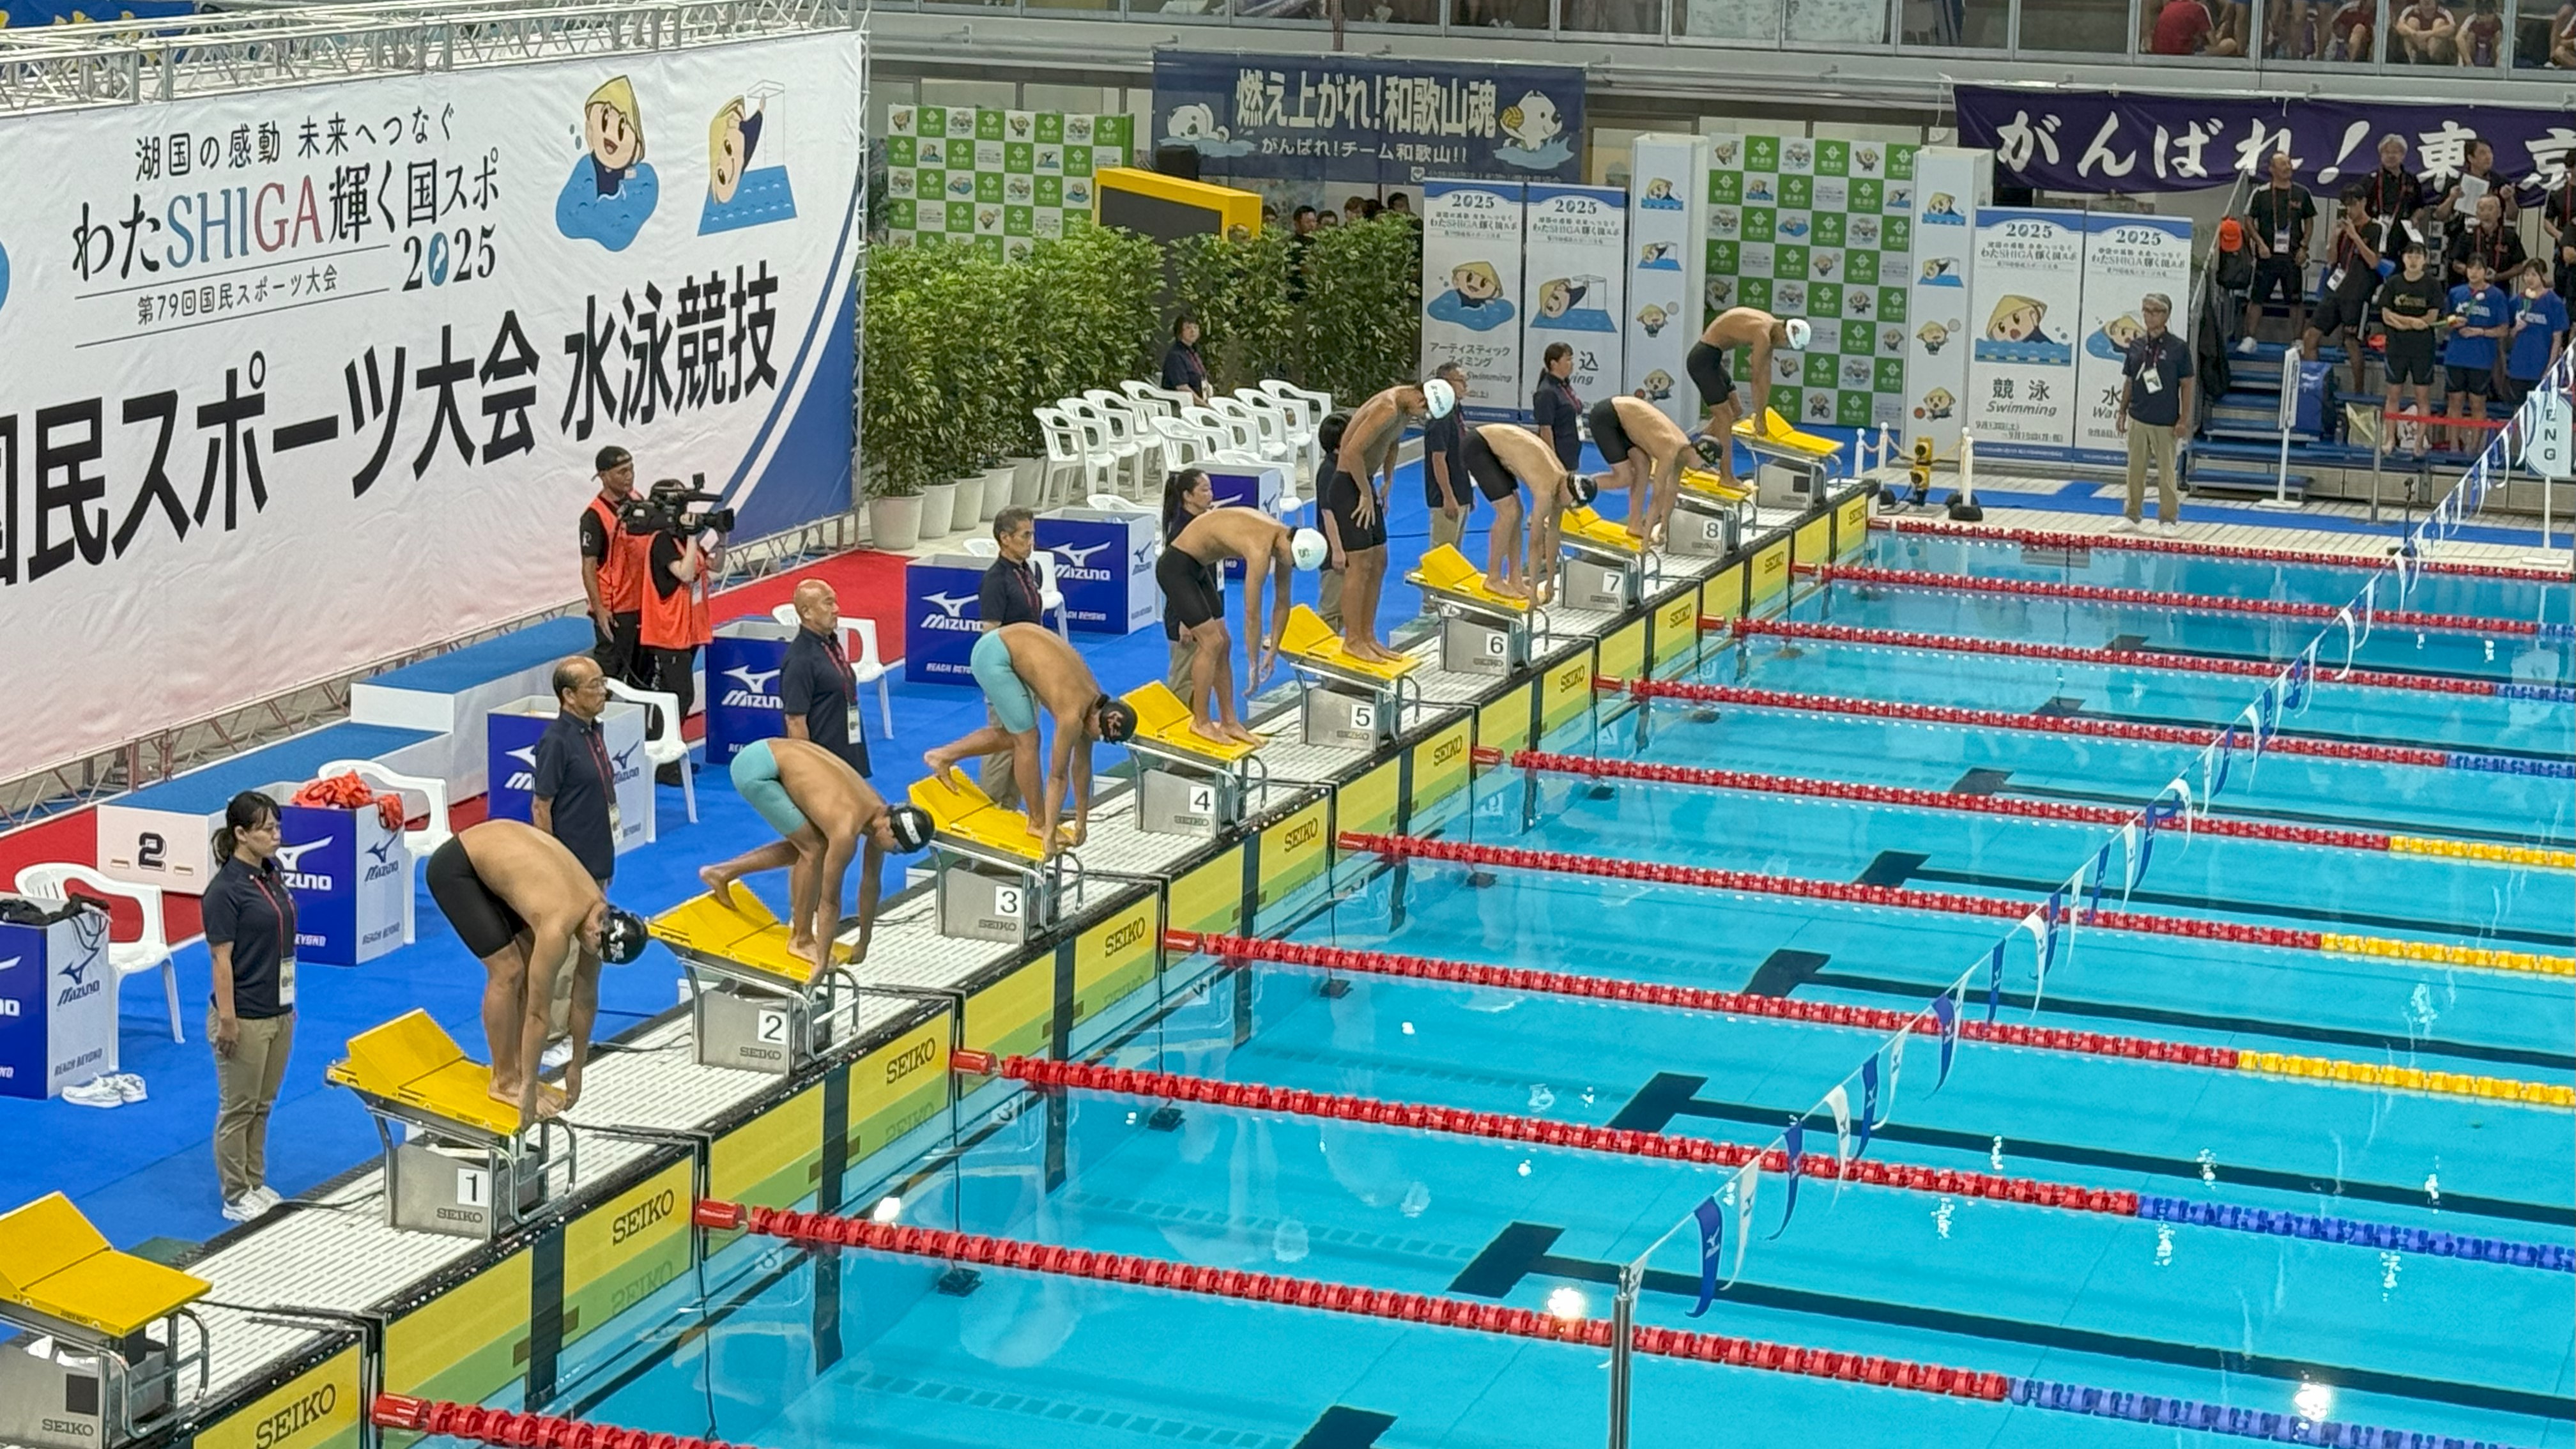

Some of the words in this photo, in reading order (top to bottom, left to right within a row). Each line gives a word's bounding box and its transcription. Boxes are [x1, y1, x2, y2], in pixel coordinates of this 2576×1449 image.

[135, 121, 281, 181] 湖国の感動
[298, 102, 456, 160] 未来へつなぐ
[1452, 194, 1494, 208] 2025
[1554, 199, 1597, 215] 2025
[73, 147, 500, 283] わたSHIGA輝く国スポ
[2005, 223, 2053, 238] 2025
[2115, 229, 2162, 246] 2025
[401, 223, 496, 292] 2025
[137, 264, 338, 327] 第79回国民スポーツ大会
[1986, 401, 2057, 417] Swimming
[0, 309, 540, 586] 民スポーツ大会
[561, 261, 779, 442] 水泳競技
[1706, 522, 1719, 539] 8
[1607, 574, 1621, 592] 7
[1490, 636, 1504, 654] 6
[1355, 707, 1370, 727] 5
[1434, 735, 1462, 767] SEIKO
[1193, 791, 1211, 811] 4
[1285, 817, 1319, 852] SEIKO
[138, 832, 165, 868] 2
[1000, 891, 1018, 914] 3
[978, 919, 1017, 932] SEIKO
[1105, 917, 1146, 958] SEIKO
[764, 1015, 783, 1041] 2
[54, 1060, 75, 1077] REACH
[76, 1048, 103, 1070] BEYOND
[740, 1046, 782, 1061] SEIKO
[886, 1037, 937, 1086] SEIKO
[464, 1173, 477, 1203] 1
[437, 1207, 484, 1223] SEIKO
[613, 1188, 675, 1246] SEIKO
[42, 1418, 95, 1438] SEIKO
[256, 1383, 337, 1449] SEIKO
